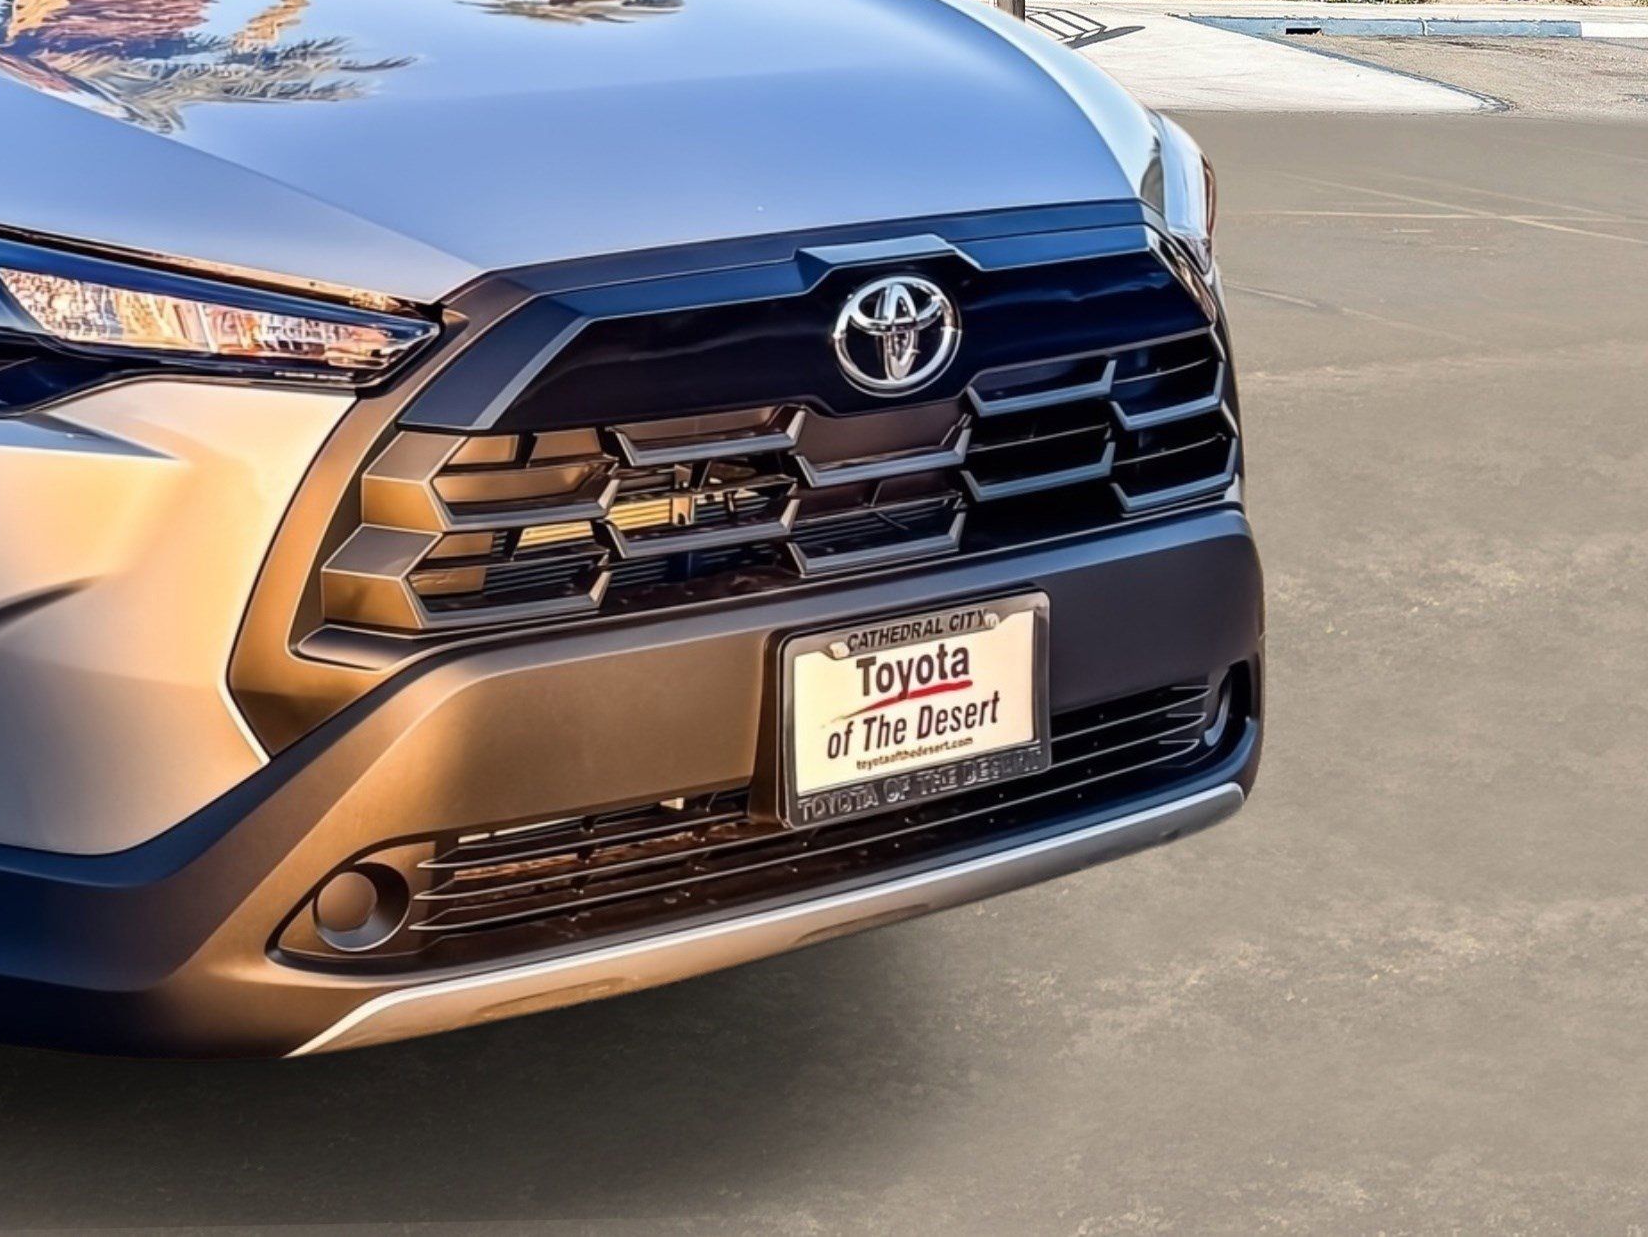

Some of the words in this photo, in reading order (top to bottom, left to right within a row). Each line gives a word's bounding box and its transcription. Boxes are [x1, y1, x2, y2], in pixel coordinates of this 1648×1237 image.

[847, 616, 943, 651] CATHEDRAL
[949, 609, 987, 632] CITY
[856, 643, 970, 700] Toyota
[827, 721, 853, 759] of
[863, 713, 907, 752] The
[916, 690, 1000, 739] Desert
[798, 784, 879, 821] TOYOTA
